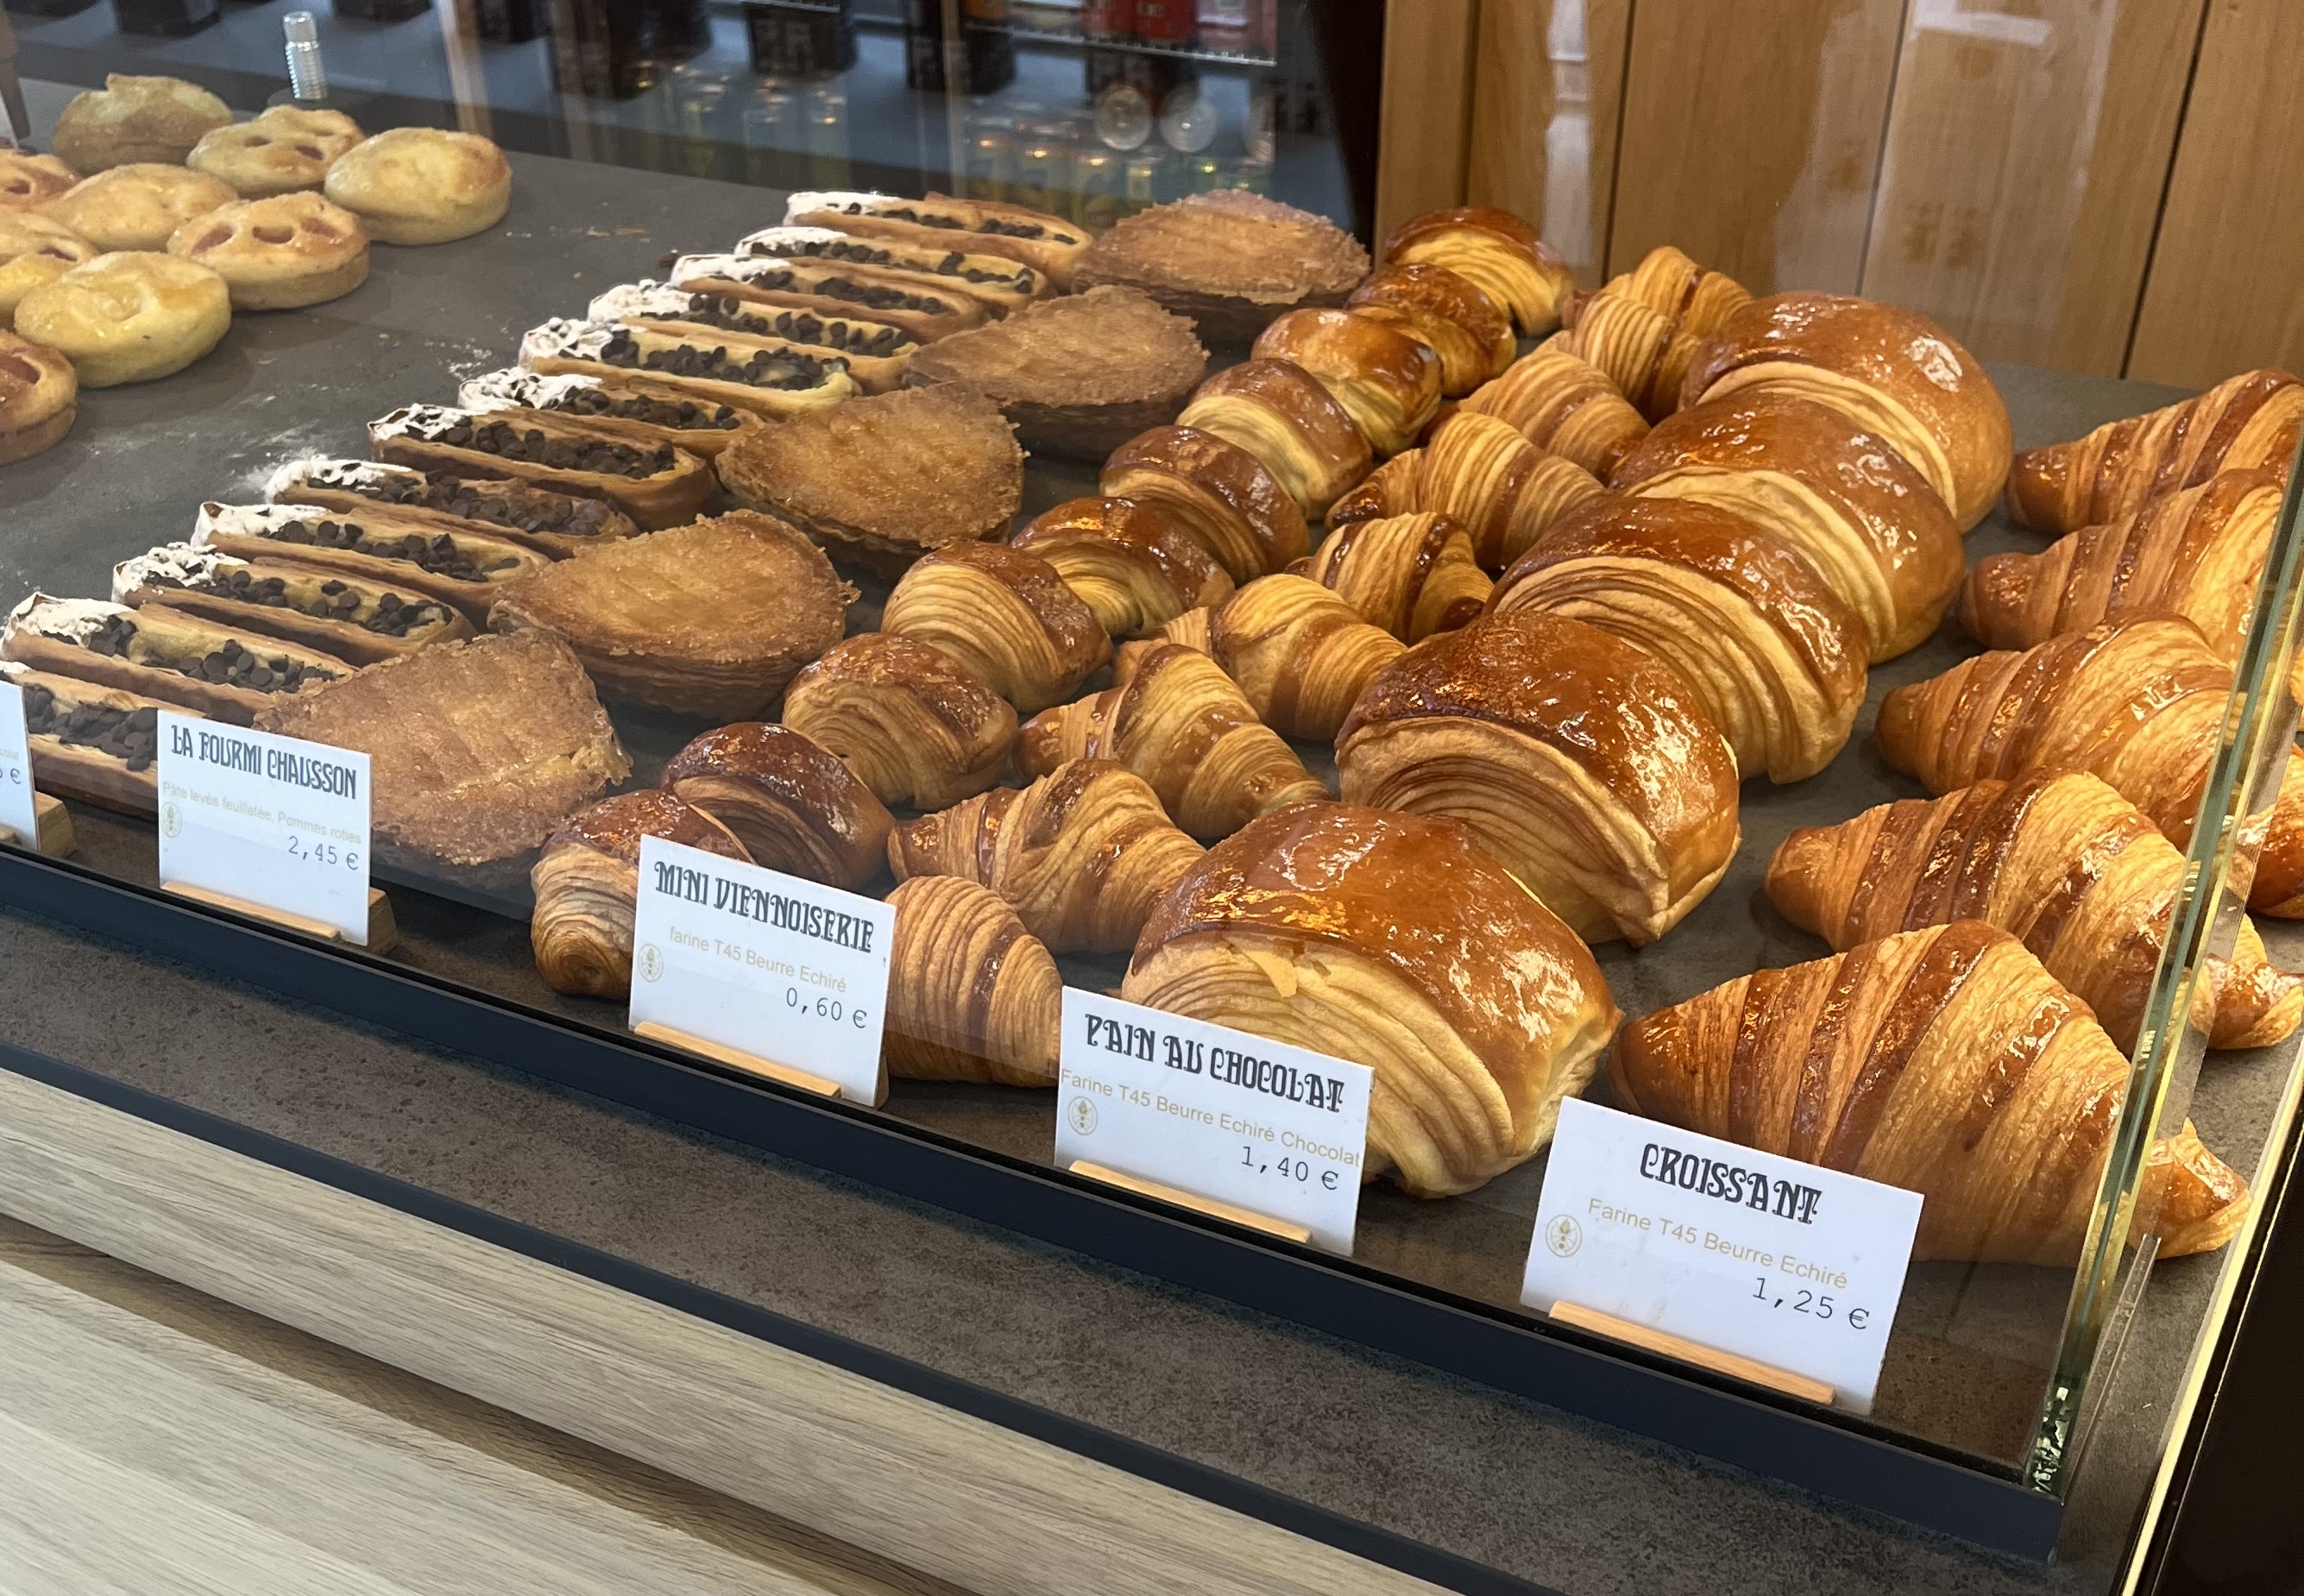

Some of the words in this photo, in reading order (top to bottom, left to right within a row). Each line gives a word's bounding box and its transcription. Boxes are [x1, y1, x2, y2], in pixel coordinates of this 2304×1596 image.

[171, 725, 193, 757] LA
[198, 732, 261, 775] FOURMI
[267, 749, 356, 800] CHAUSSON
[163, 781, 187, 800] Pâte
[190, 789, 219, 807] levée
[278, 811, 327, 836] Pommes
[288, 835, 337, 864] 2,45
[346, 852, 358, 870] €
[654, 861, 708, 905] MINI
[714, 877, 874, 953] VIENNOISERIE
[670, 926, 709, 951] farine
[714, 939, 741, 961] T45
[746, 950, 795, 977] Beurre
[800, 965, 847, 992] Echiré
[786, 987, 842, 1021] 0,60
[853, 1009, 867, 1028] €
[1085, 1014, 1156, 1062] PAIN
[1162, 1035, 1204, 1074] AU
[1210, 1046, 1344, 1113] CHOCOLAT
[1061, 1069, 1112, 1097] Farine
[1119, 1084, 1150, 1107] T45
[1156, 1096, 1213, 1124] Beurre
[1219, 1113, 1275, 1142] Echiré
[1281, 1131, 1360, 1167] Chocolat
[1241, 1146, 1308, 1182] 1,40
[1321, 1171, 1339, 1190] €
[1640, 1142, 1822, 1225] CROISSANT
[1588, 1197, 1652, 1231] Farine
[1659, 1217, 1697, 1244] T45
[1703, 1234, 1773, 1267] Beurre
[1780, 1255, 1848, 1290] Echiré
[1753, 1277, 1834, 1319] 1,25
[1848, 1308, 1870, 1330] €
